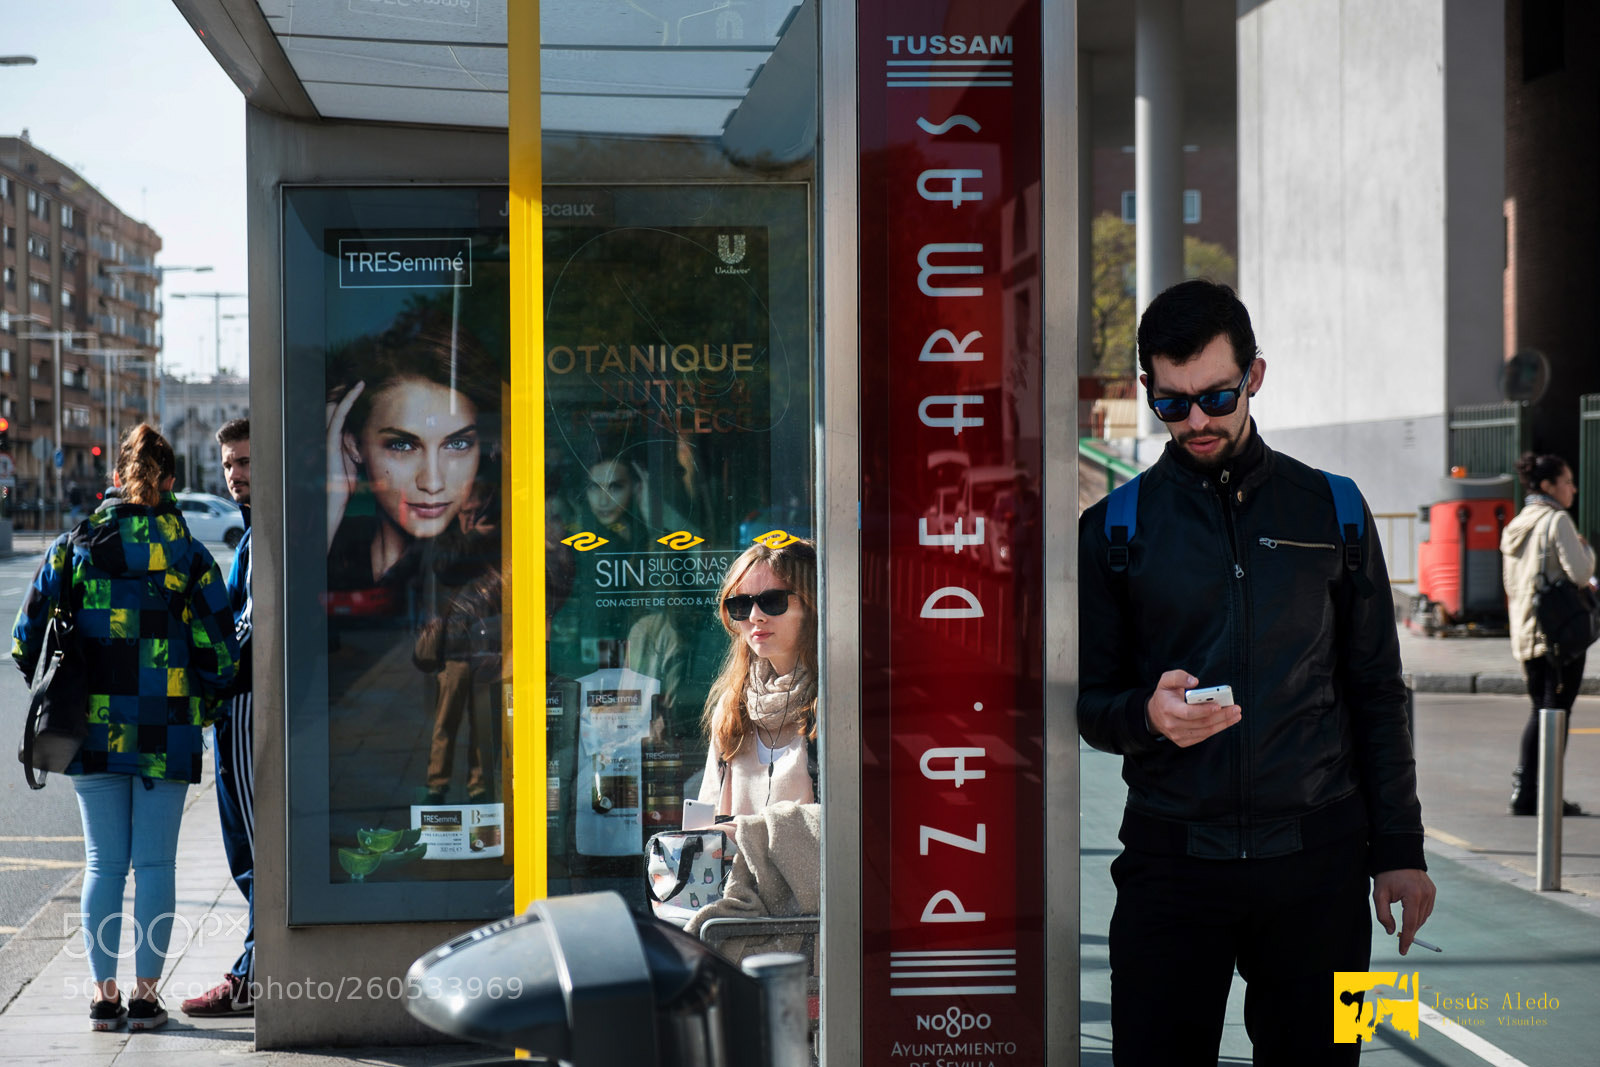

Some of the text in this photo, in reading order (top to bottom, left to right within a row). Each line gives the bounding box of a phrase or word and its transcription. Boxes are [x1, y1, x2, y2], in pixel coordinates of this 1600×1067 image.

[886, 35, 1013, 55] TUSSAM
[498, 200, 596, 217] Jecaux
[345, 251, 464, 273] TRESemmé
[714, 265, 751, 275] Unilever
[916, 113, 984, 436] ARMAS
[547, 343, 754, 374] OTANIQUE
[594, 556, 728, 588] SIN SILICONAS
[919, 516, 985, 619] DE
[648, 572, 727, 586] COLORAN
[595, 599, 617, 608] CON
[618, 598, 651, 607] ACEITE
[653, 598, 665, 606] DE
[667, 597, 695, 606] COCO
[423, 814, 458, 824] TRESemmé
[890, 1041, 1017, 1057] AYUNTAMIENTO
